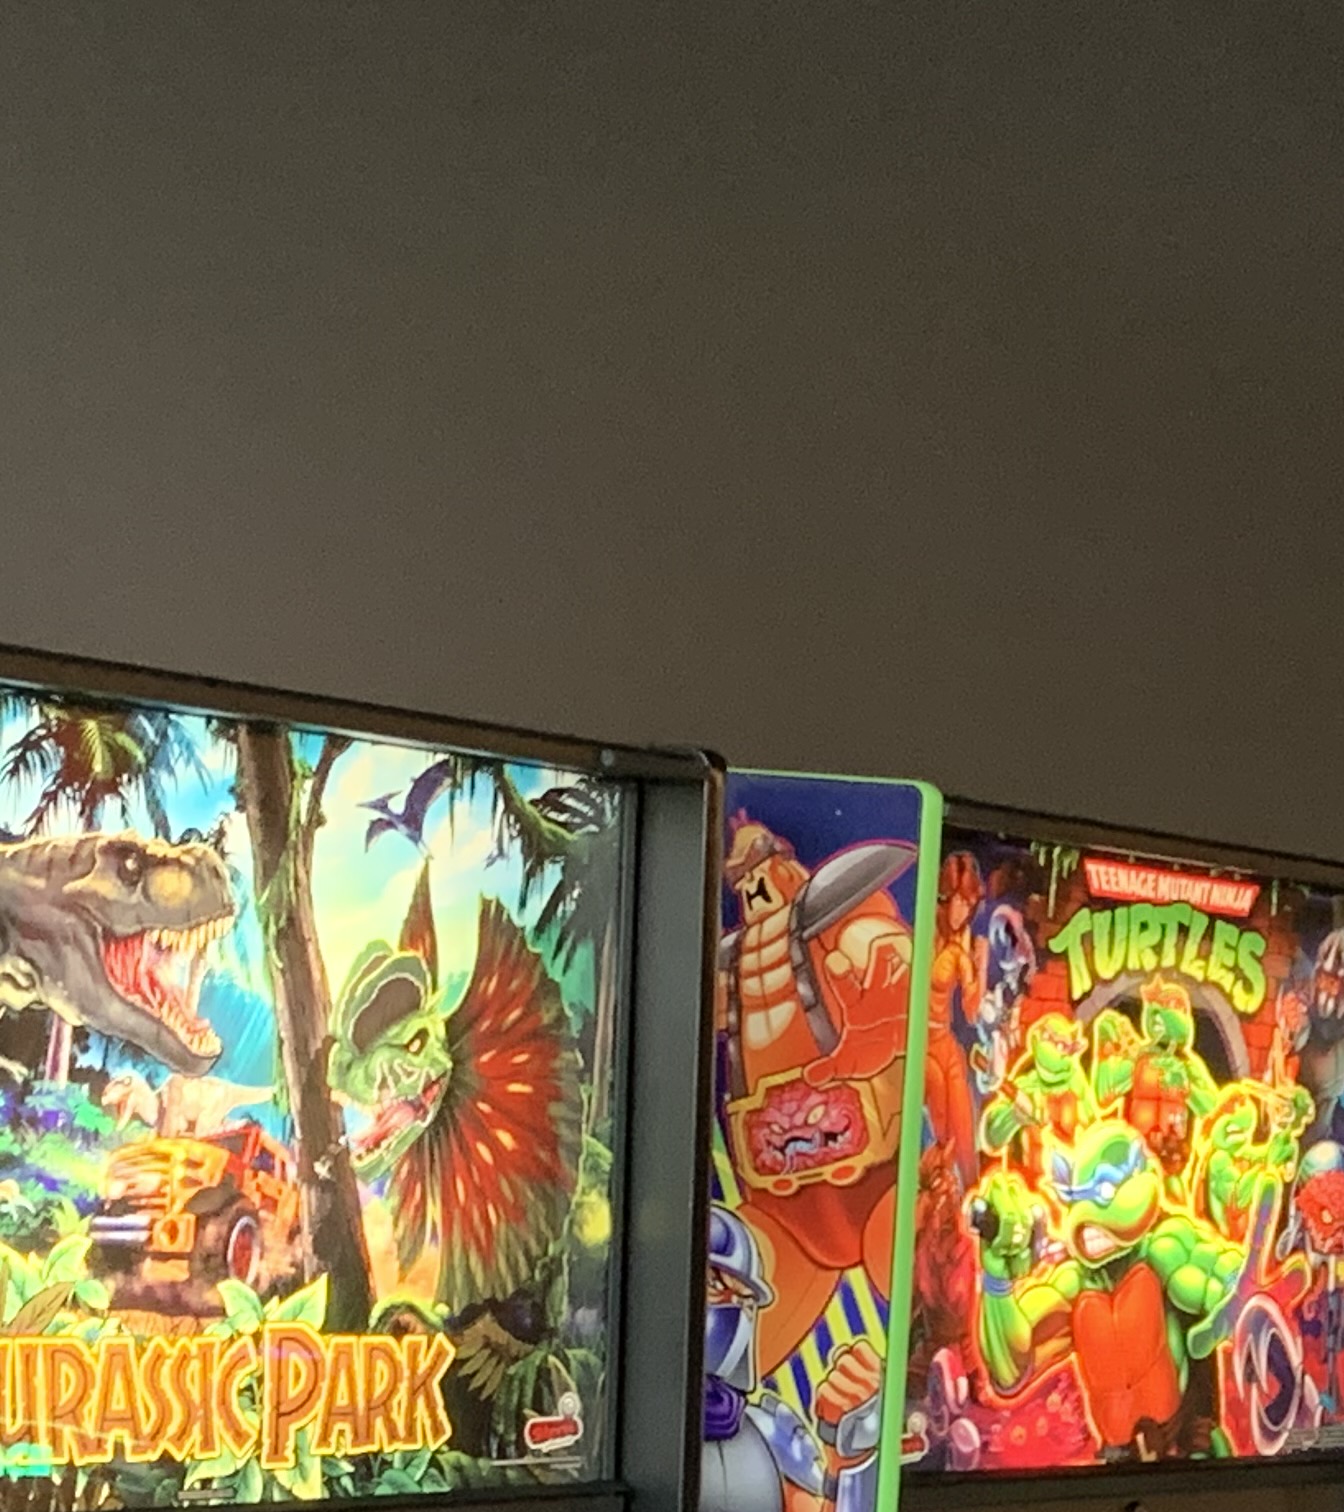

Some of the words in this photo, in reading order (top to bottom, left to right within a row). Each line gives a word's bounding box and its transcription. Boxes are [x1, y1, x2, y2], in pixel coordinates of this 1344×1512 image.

[1086, 862, 1156, 898] TEENAGE
[1157, 875, 1210, 905] MUTANT
[1210, 883, 1254, 912] NINJA
[1048, 902, 1266, 1014] TURTLES
[0, 1335, 259, 1465] URASSIC
[261, 1322, 455, 1469] PARK
